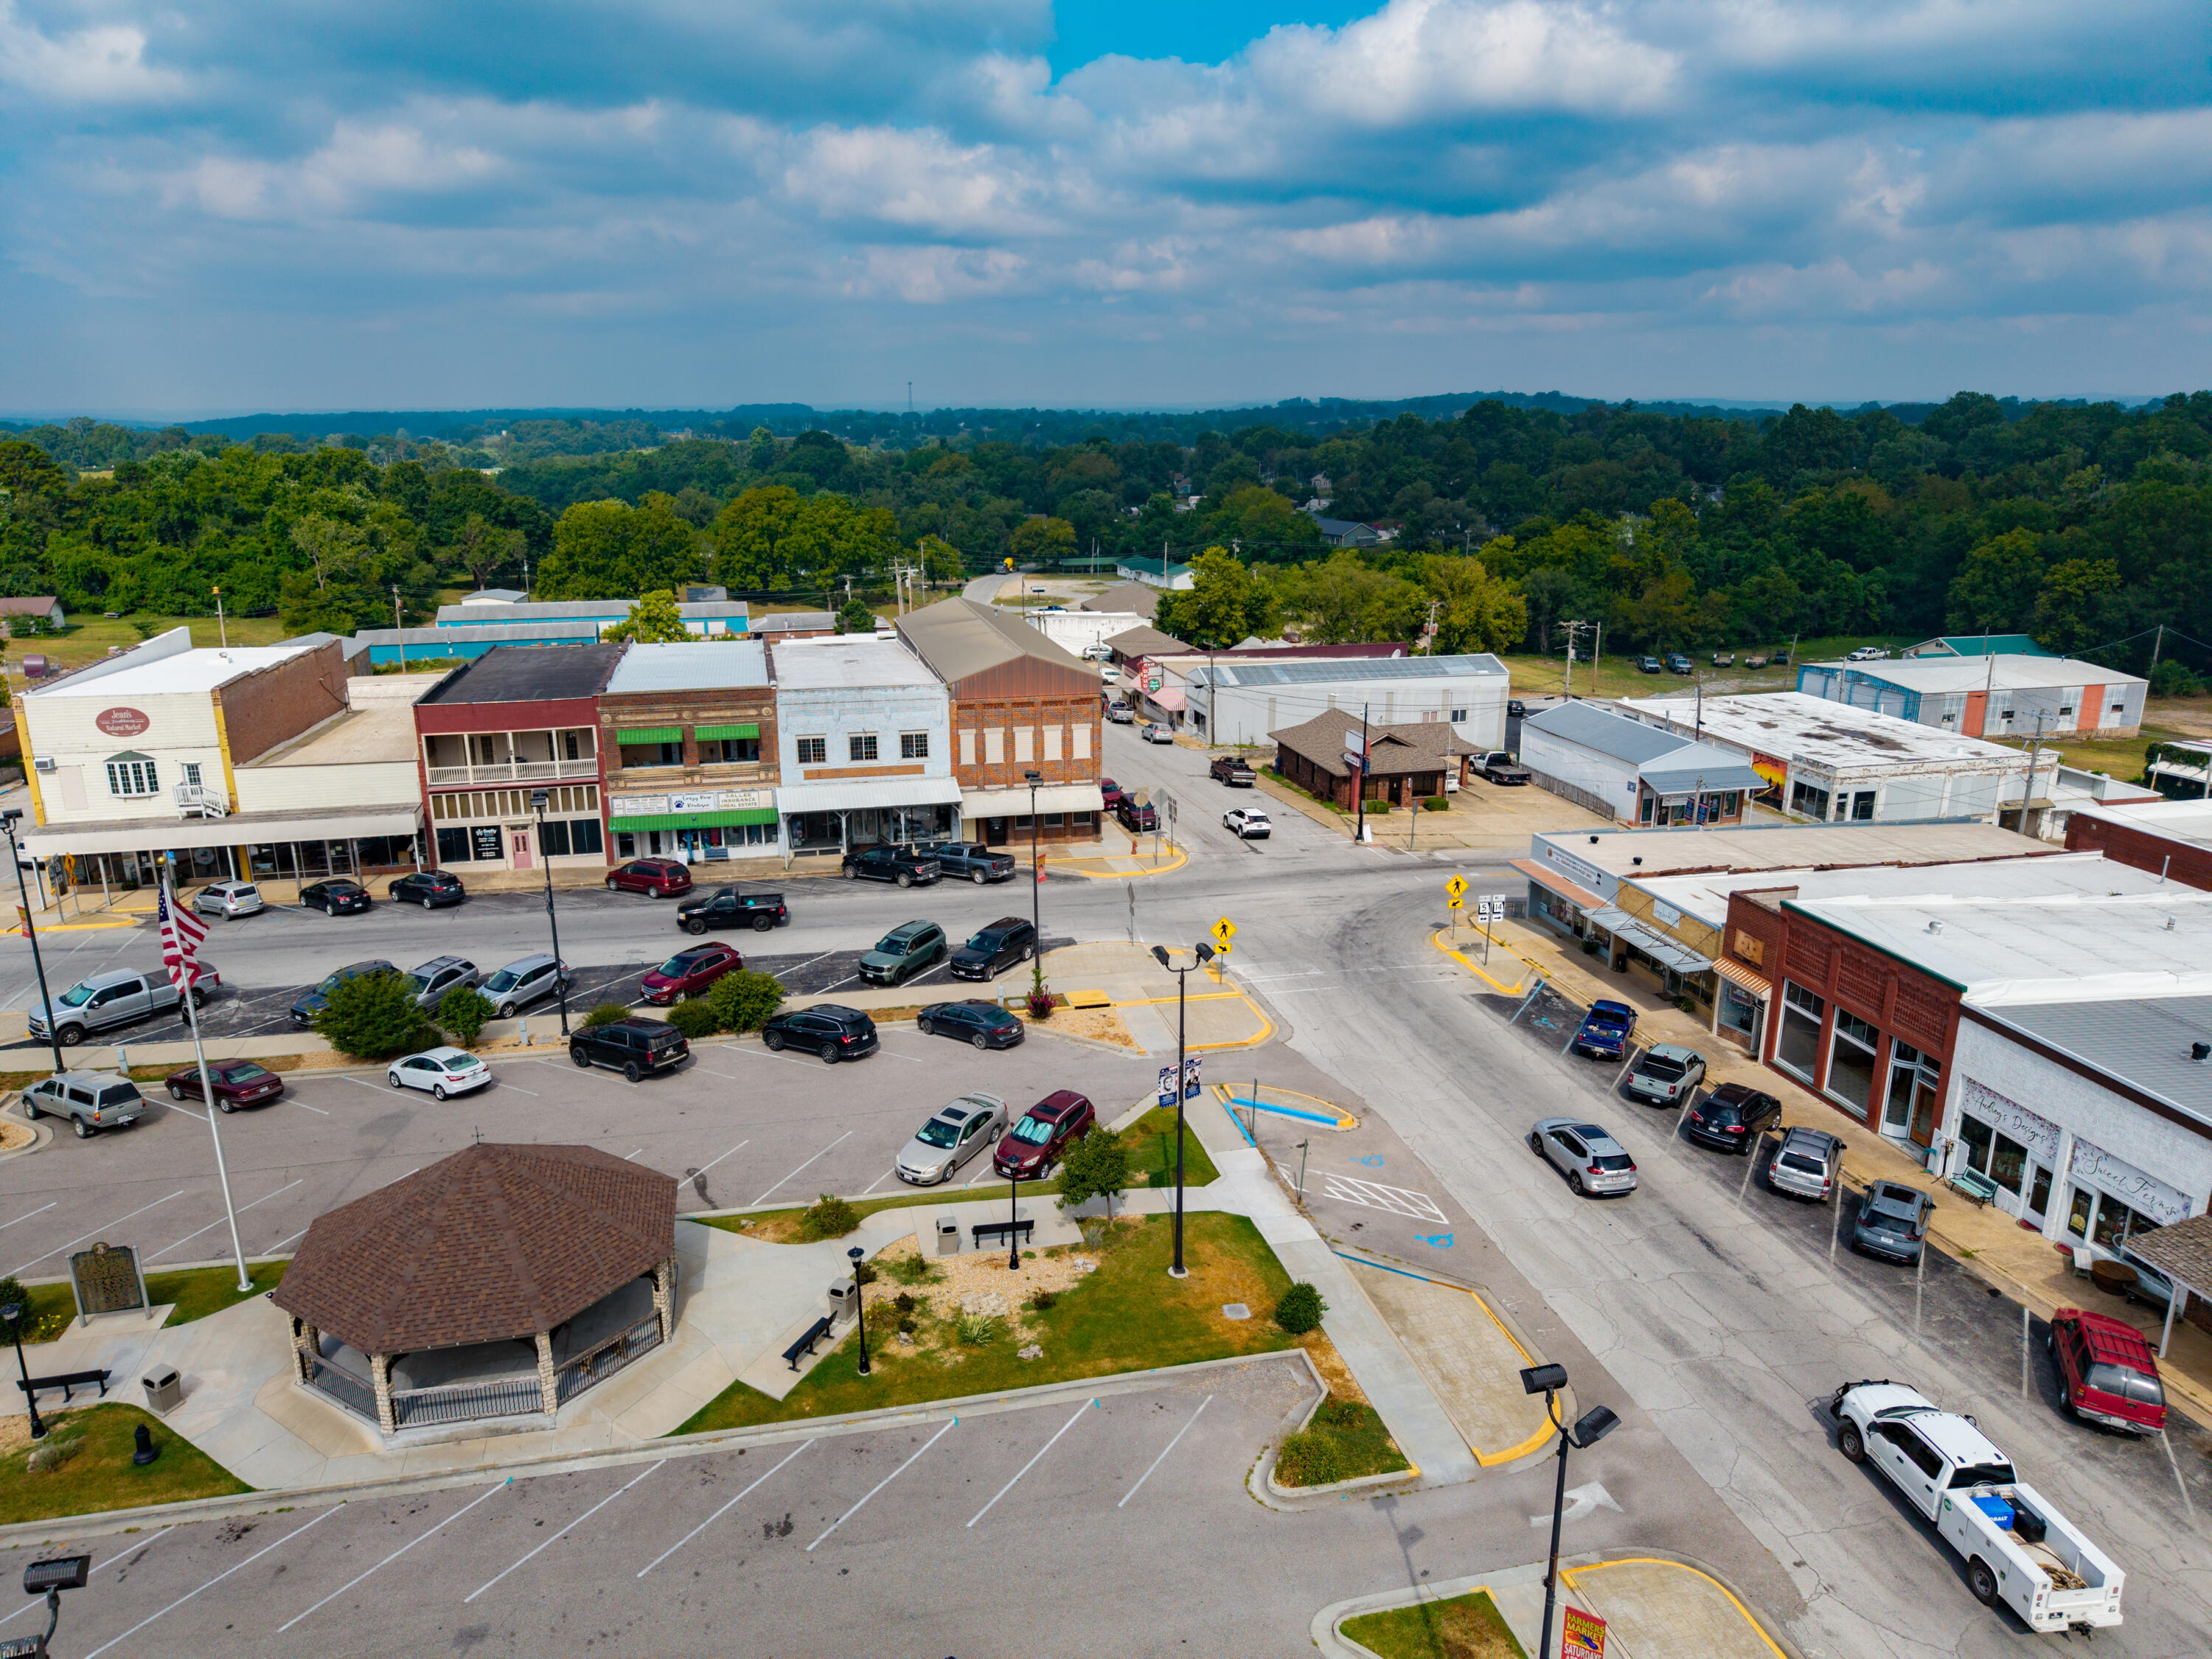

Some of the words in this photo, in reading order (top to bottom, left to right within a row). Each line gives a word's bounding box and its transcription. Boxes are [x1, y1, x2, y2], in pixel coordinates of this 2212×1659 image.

[111, 710, 132, 719] Jean's
[1495, 903, 1502, 911] 14
[1975, 1096, 2007, 1123] Audrey's
[2011, 1116, 2048, 1144] Designs
[2082, 1156, 2127, 1186] Sweet
[2126, 1177, 2180, 1216] Fern's
[1567, 1613, 1604, 1635] FARMERS
[1567, 1621, 1604, 1642] MARKET
